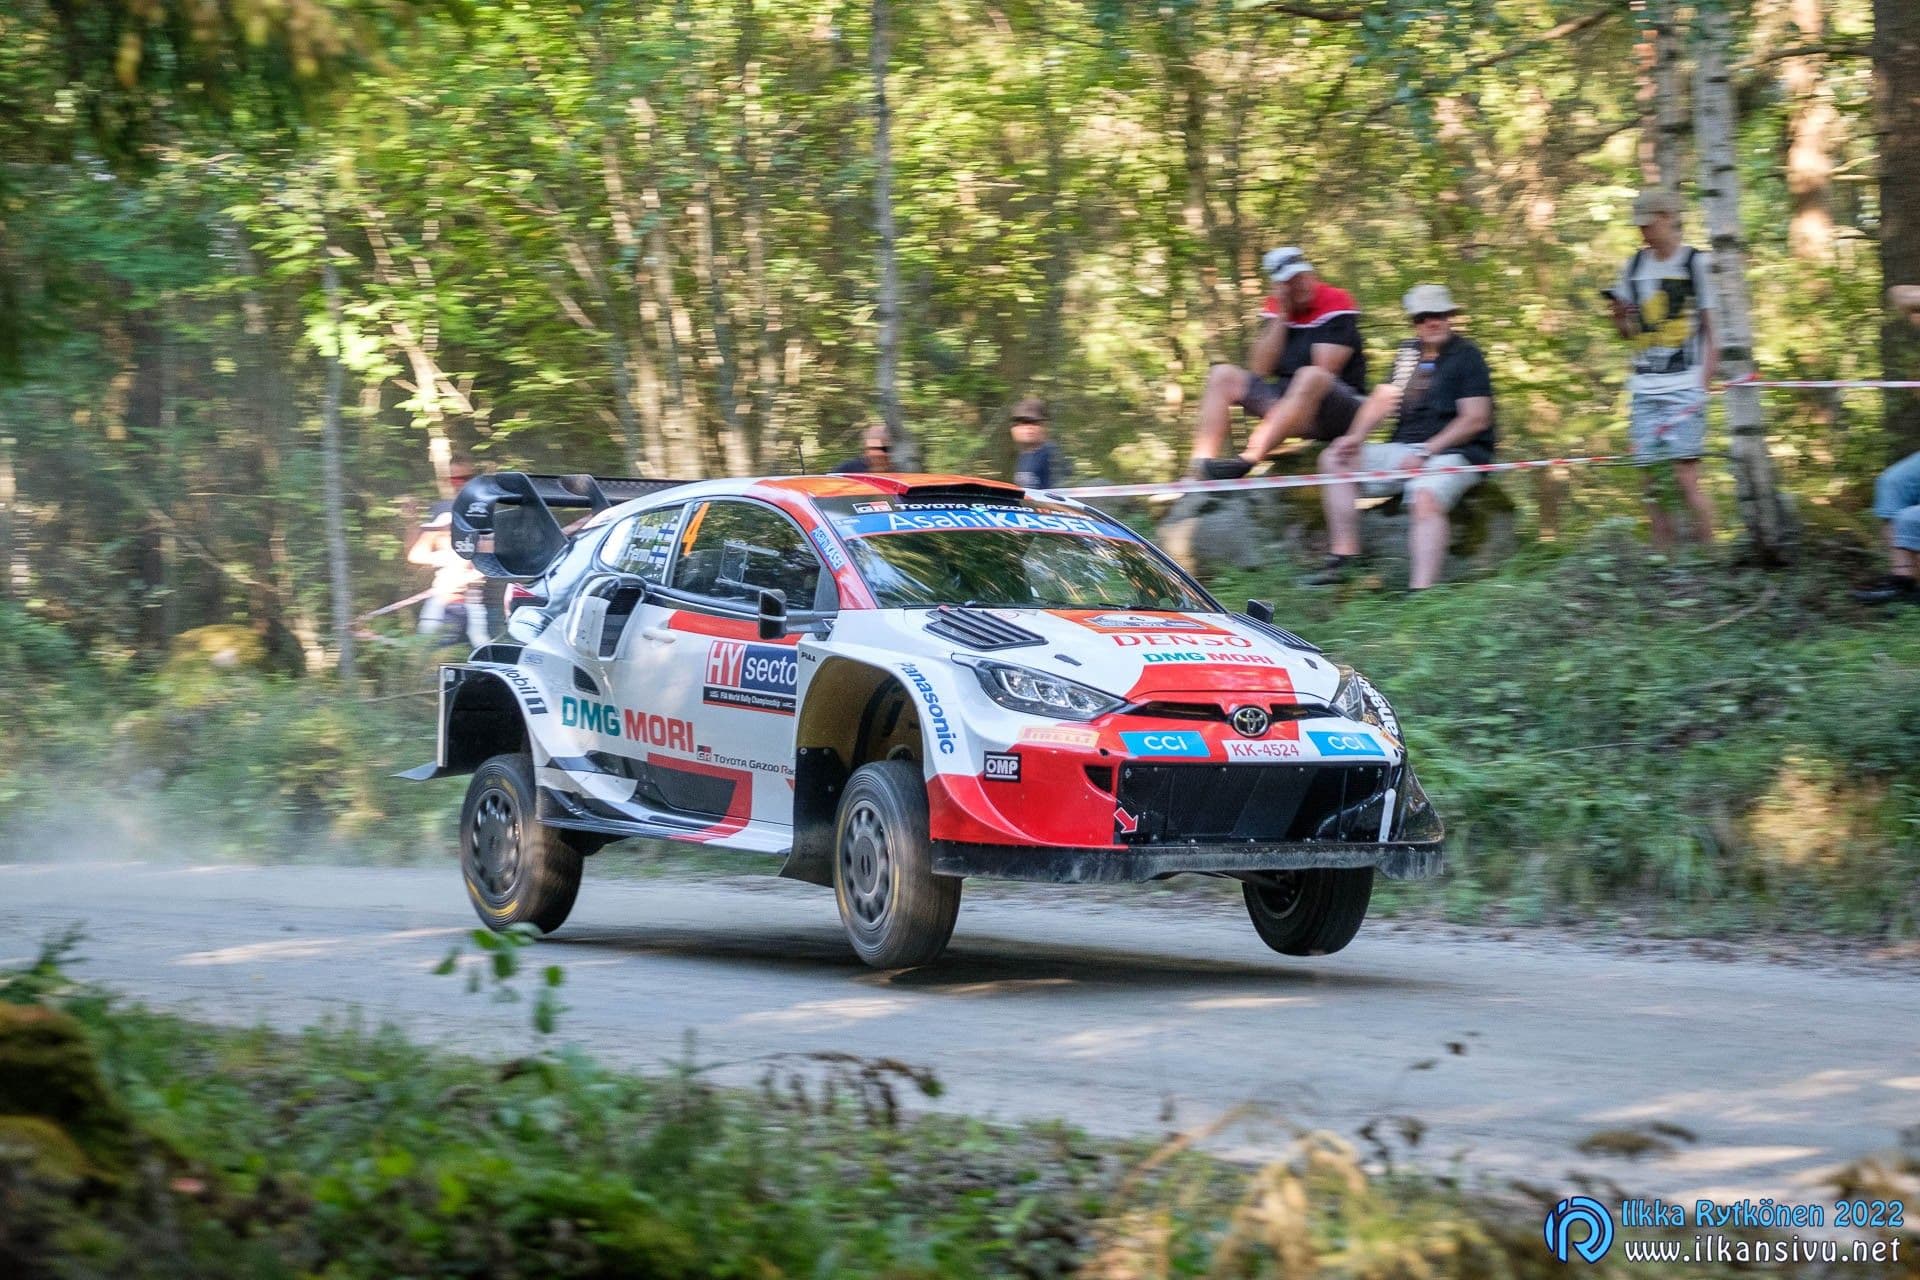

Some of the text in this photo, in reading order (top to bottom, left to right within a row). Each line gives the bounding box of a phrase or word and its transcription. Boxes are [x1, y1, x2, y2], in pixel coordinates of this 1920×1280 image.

[681, 502, 711, 557] 4
[1112, 635, 1252, 648] DENSO
[1143, 652, 1275, 665] DMG MORI
[901, 663, 957, 754] Panasonic
[562, 696, 695, 753] DMG MORI
[1143, 735, 1188, 751] CCI
[1231, 743, 1299, 757] KK-4524
[1327, 735, 1362, 751] CCI
[713, 753, 747, 768] TOYOTA
[749, 759, 779, 773] GAZOO
[986, 759, 1018, 776] OMP
